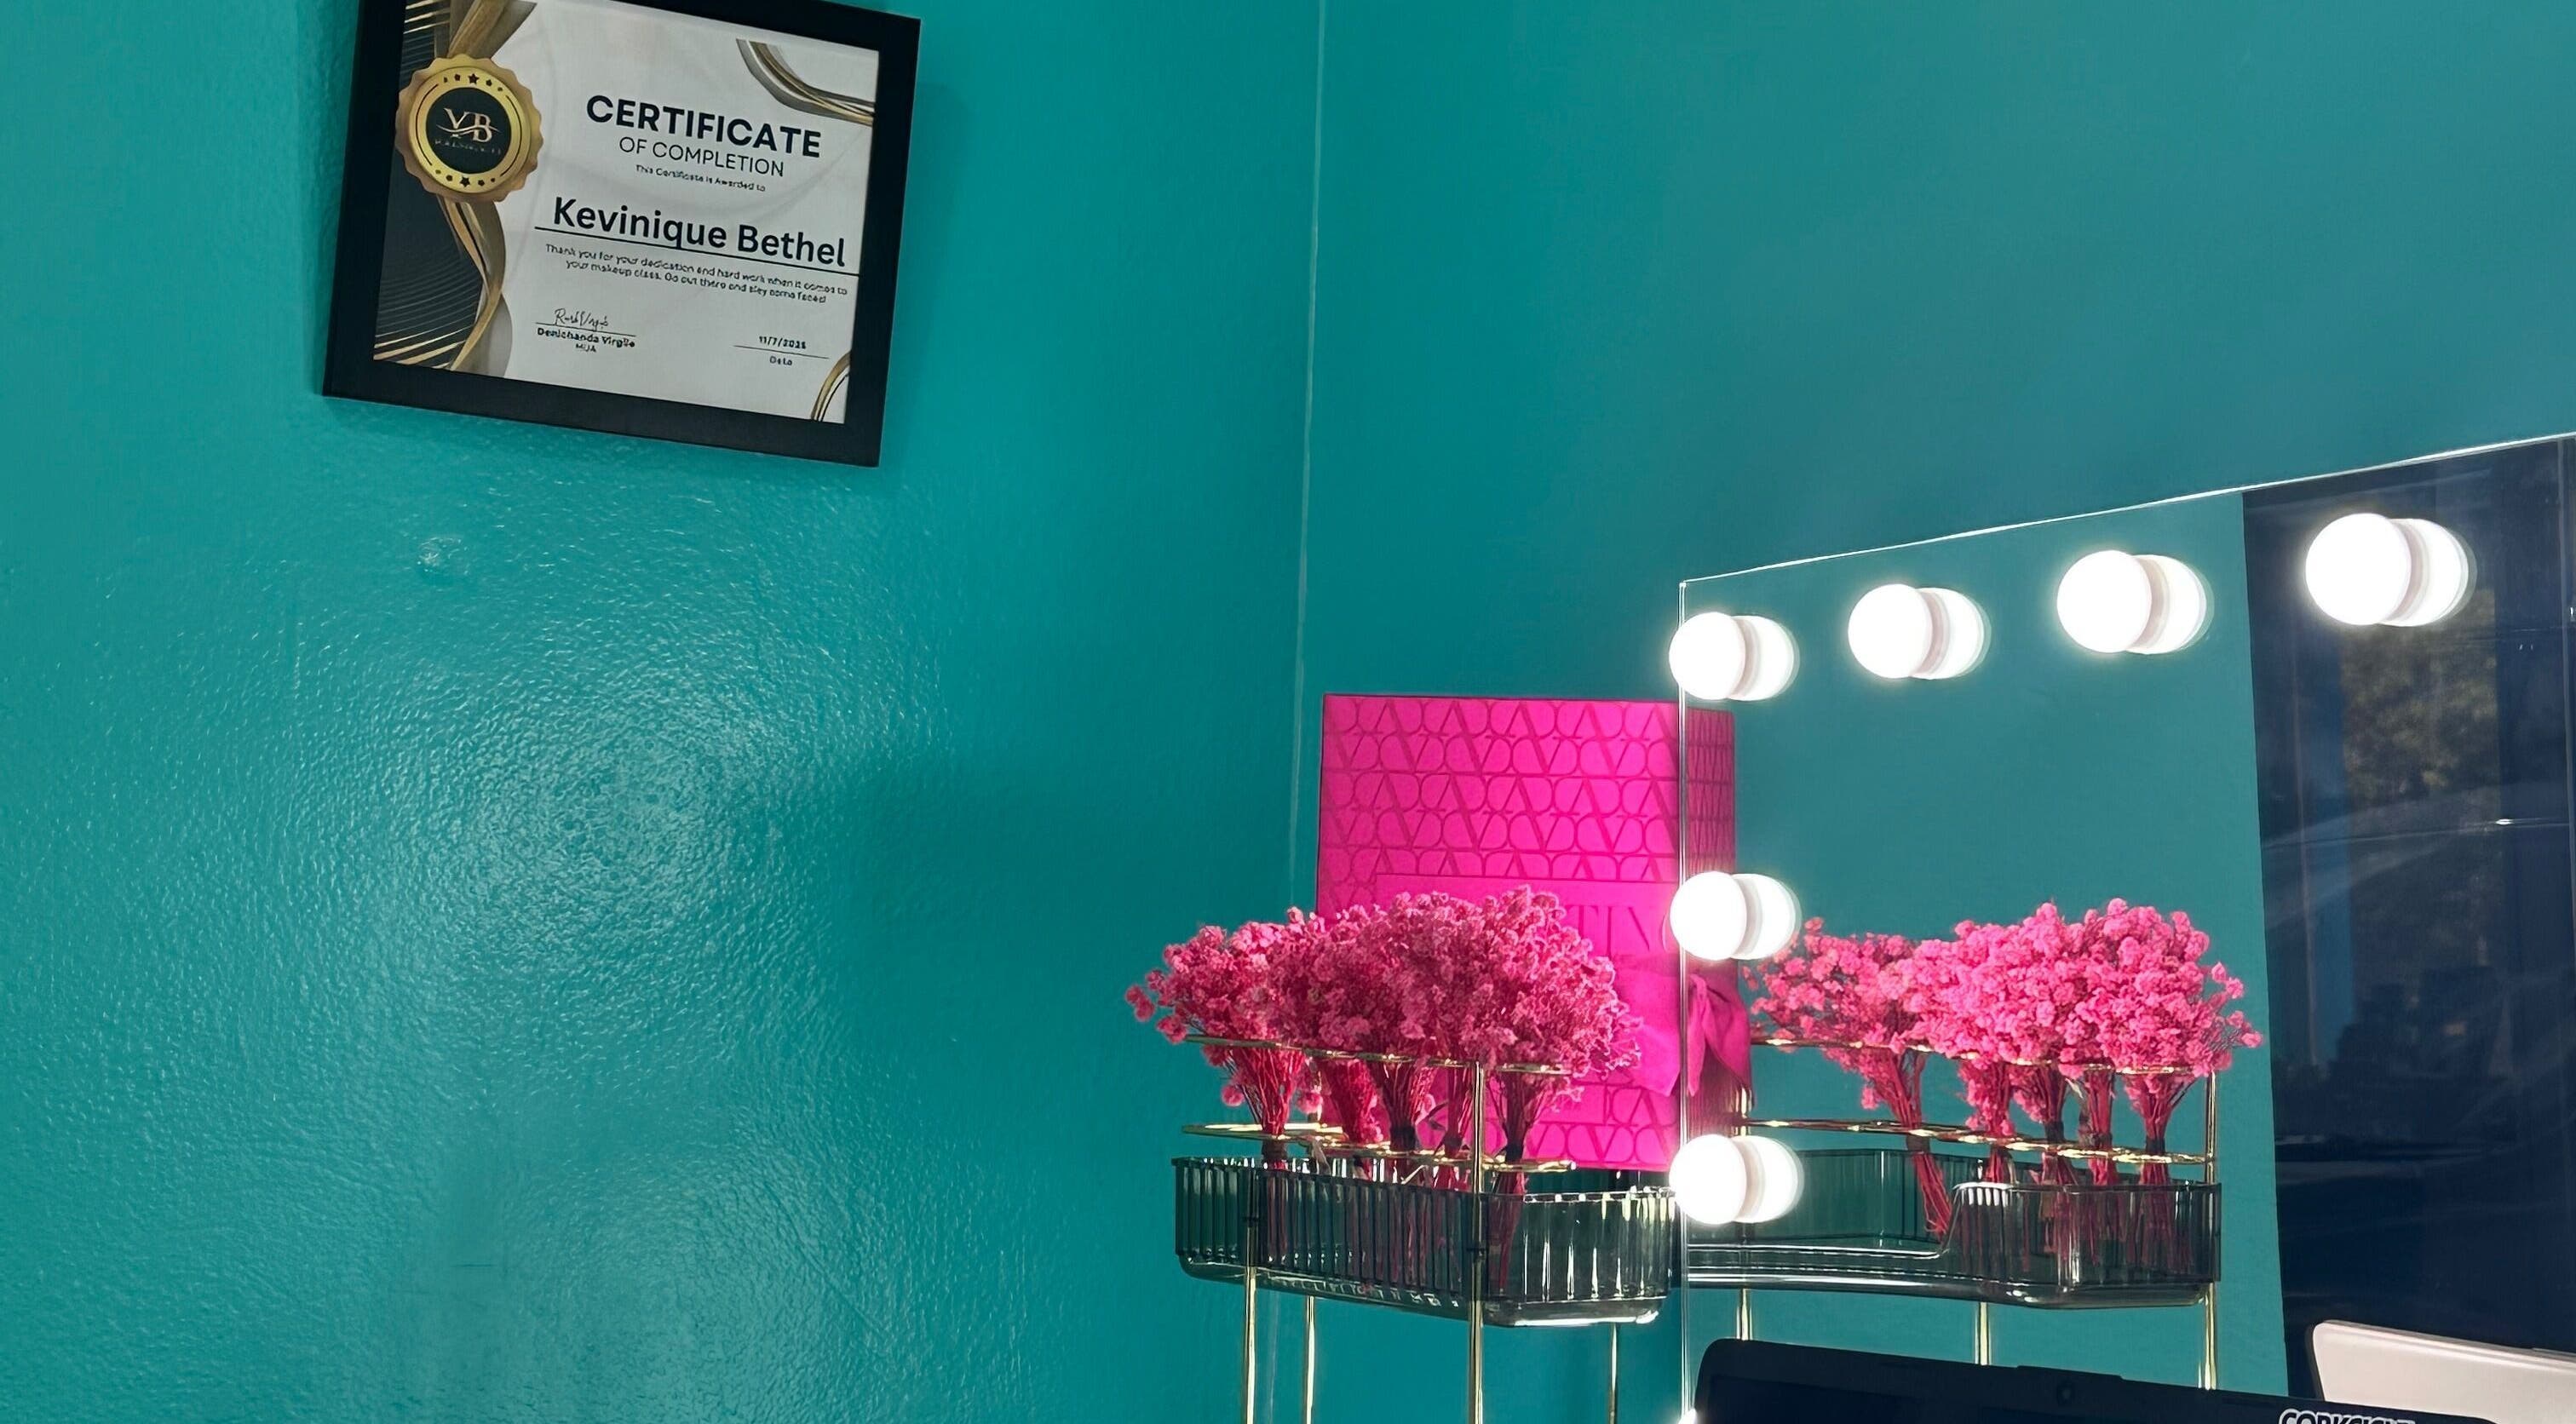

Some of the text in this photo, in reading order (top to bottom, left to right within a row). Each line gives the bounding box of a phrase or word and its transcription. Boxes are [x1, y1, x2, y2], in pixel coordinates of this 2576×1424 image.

[586, 95, 822, 158] CERTIFICATE
[619, 136, 785, 177] OF COMPLETION
[635, 164, 653, 174] This
[656, 168, 704, 182] Certificate
[715, 178, 755, 191] Awarded
[554, 196, 846, 267] Kevinique Bethel
[545, 244, 576, 256] Thank
[578, 250, 596, 260] you
[598, 251, 614, 261] for
[616, 256, 639, 266] your
[641, 257, 695, 273] dedication
[696, 266, 716, 277] and
[716, 268, 740, 280] hard
[742, 273, 765, 284] work
[767, 277, 793, 288] when
[795, 280, 802, 289] it
[803, 283, 836, 294] comes
[566, 260, 589, 270] your
[590, 263, 632, 277] makeup
[664, 272, 679, 283] Go
[681, 276, 698, 285] out
[699, 277, 727, 290] there
[728, 282, 747, 293] and
[769, 288, 796, 299] some
[769, 355, 793, 366] Date
